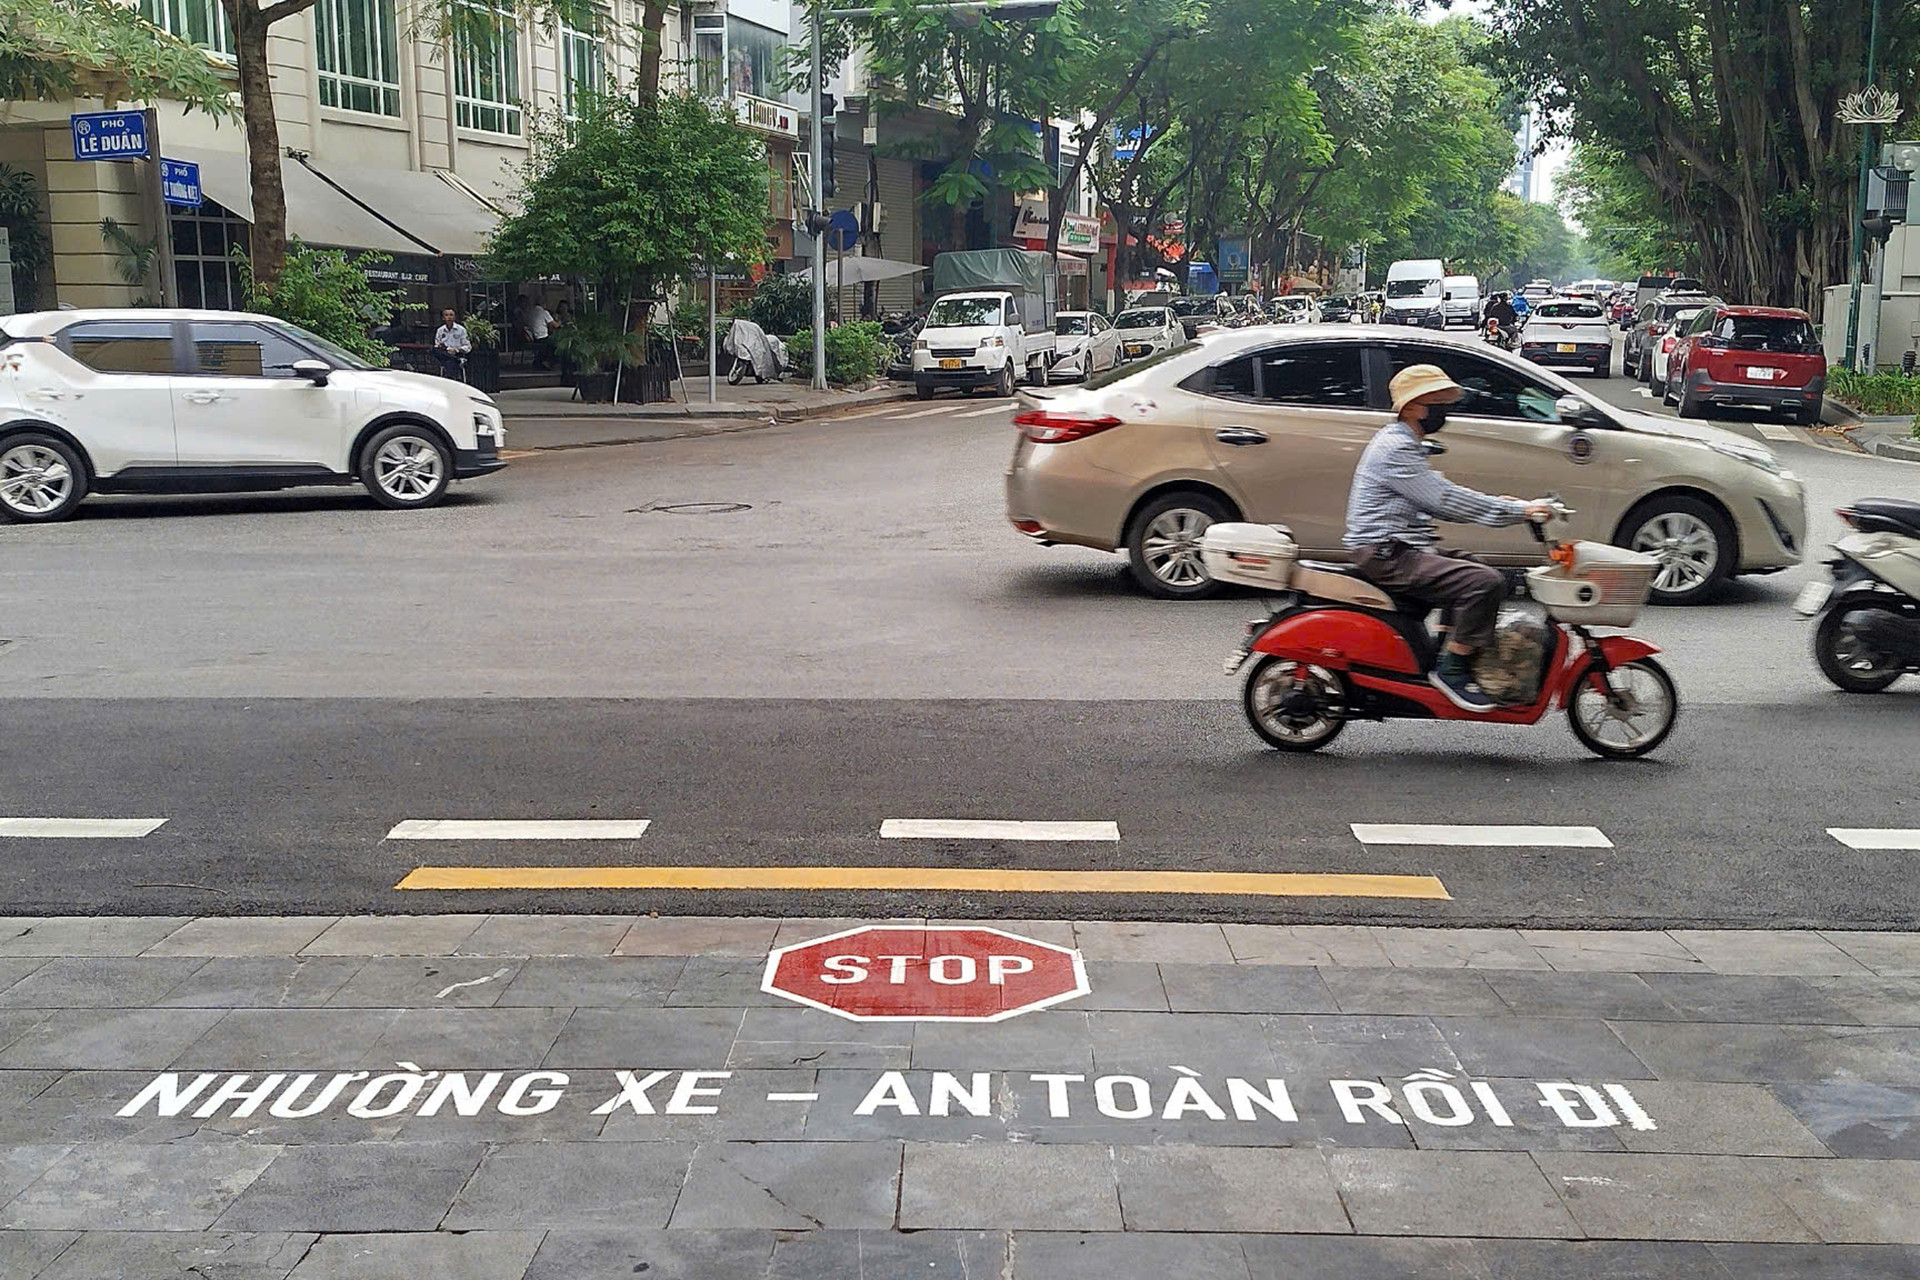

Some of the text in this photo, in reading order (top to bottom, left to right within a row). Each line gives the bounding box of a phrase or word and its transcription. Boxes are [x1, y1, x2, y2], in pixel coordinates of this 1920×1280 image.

[101, 115, 125, 129] PHỐ
[80, 128, 142, 153] LÊ DUẨN
[819, 955, 1034, 985] STOP
[114, 1061, 570, 1118] NHƯỜNG
[590, 1070, 733, 1116] XE
[853, 1071, 991, 1117] AN
[1030, 1066, 1300, 1123] TOÀN
[1328, 1068, 1513, 1128] RỒI
[1536, 1082, 1660, 1132] ĐI
